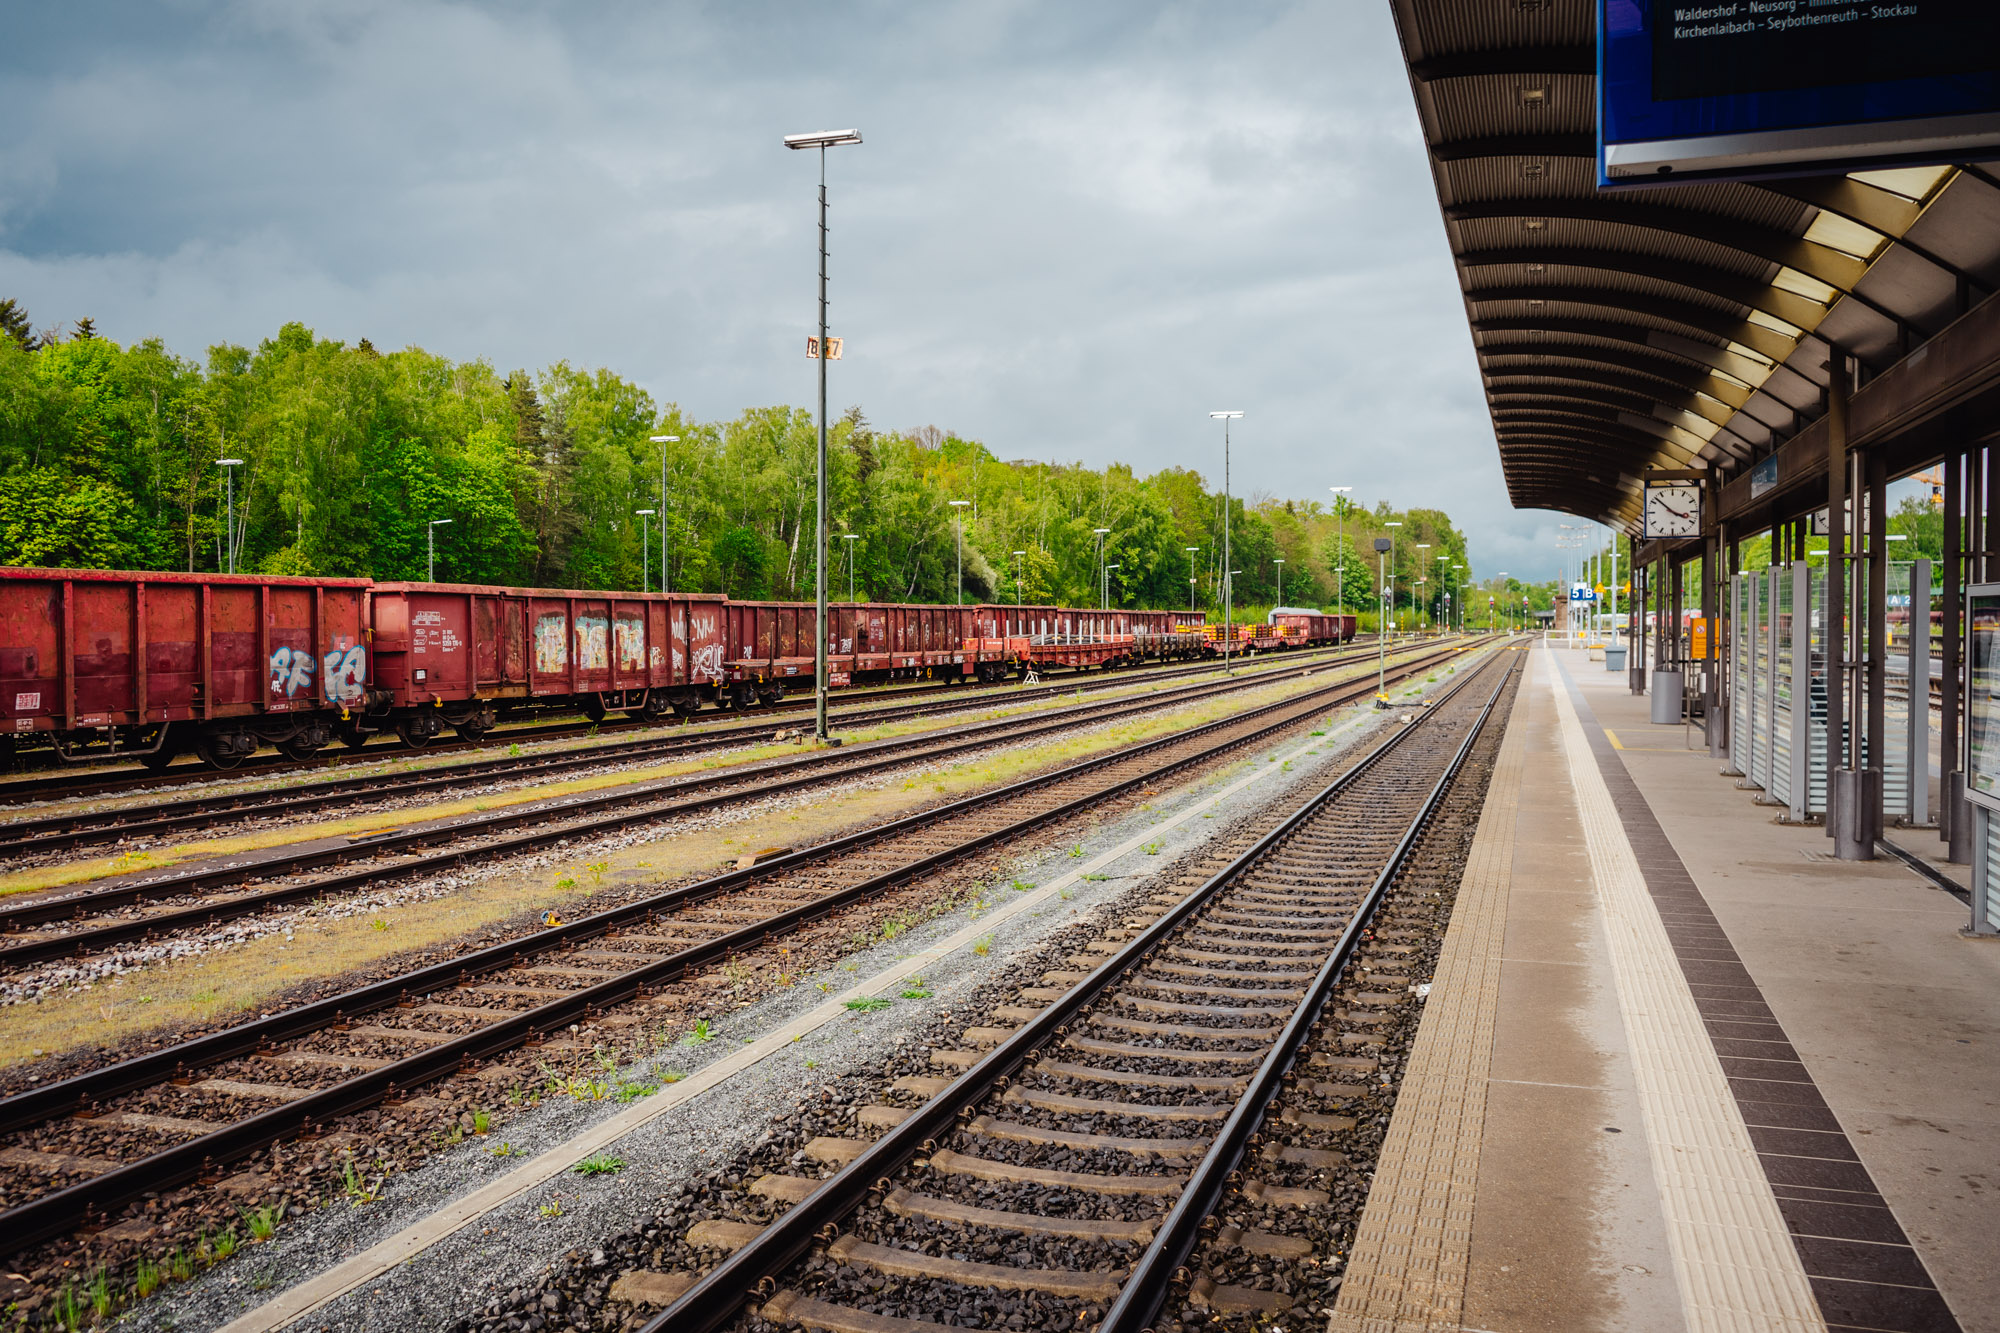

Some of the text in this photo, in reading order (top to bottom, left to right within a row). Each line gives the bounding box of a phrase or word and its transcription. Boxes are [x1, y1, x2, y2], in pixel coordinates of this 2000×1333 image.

[1674, 3, 1737, 22] Waldershof
[1749, 1, 1797, 14] Neusorg
[1674, 19, 1755, 39] Kirchenlaibach
[1767, 8, 1858, 31] Seybothenreuth
[1871, 4, 1917, 19] Stockau
[811, 340, 818, 354] 8
[832, 341, 840, 356] 7
[1572, 588, 1593, 598] 5 B
[1890, 595, 1910, 604] A 2
